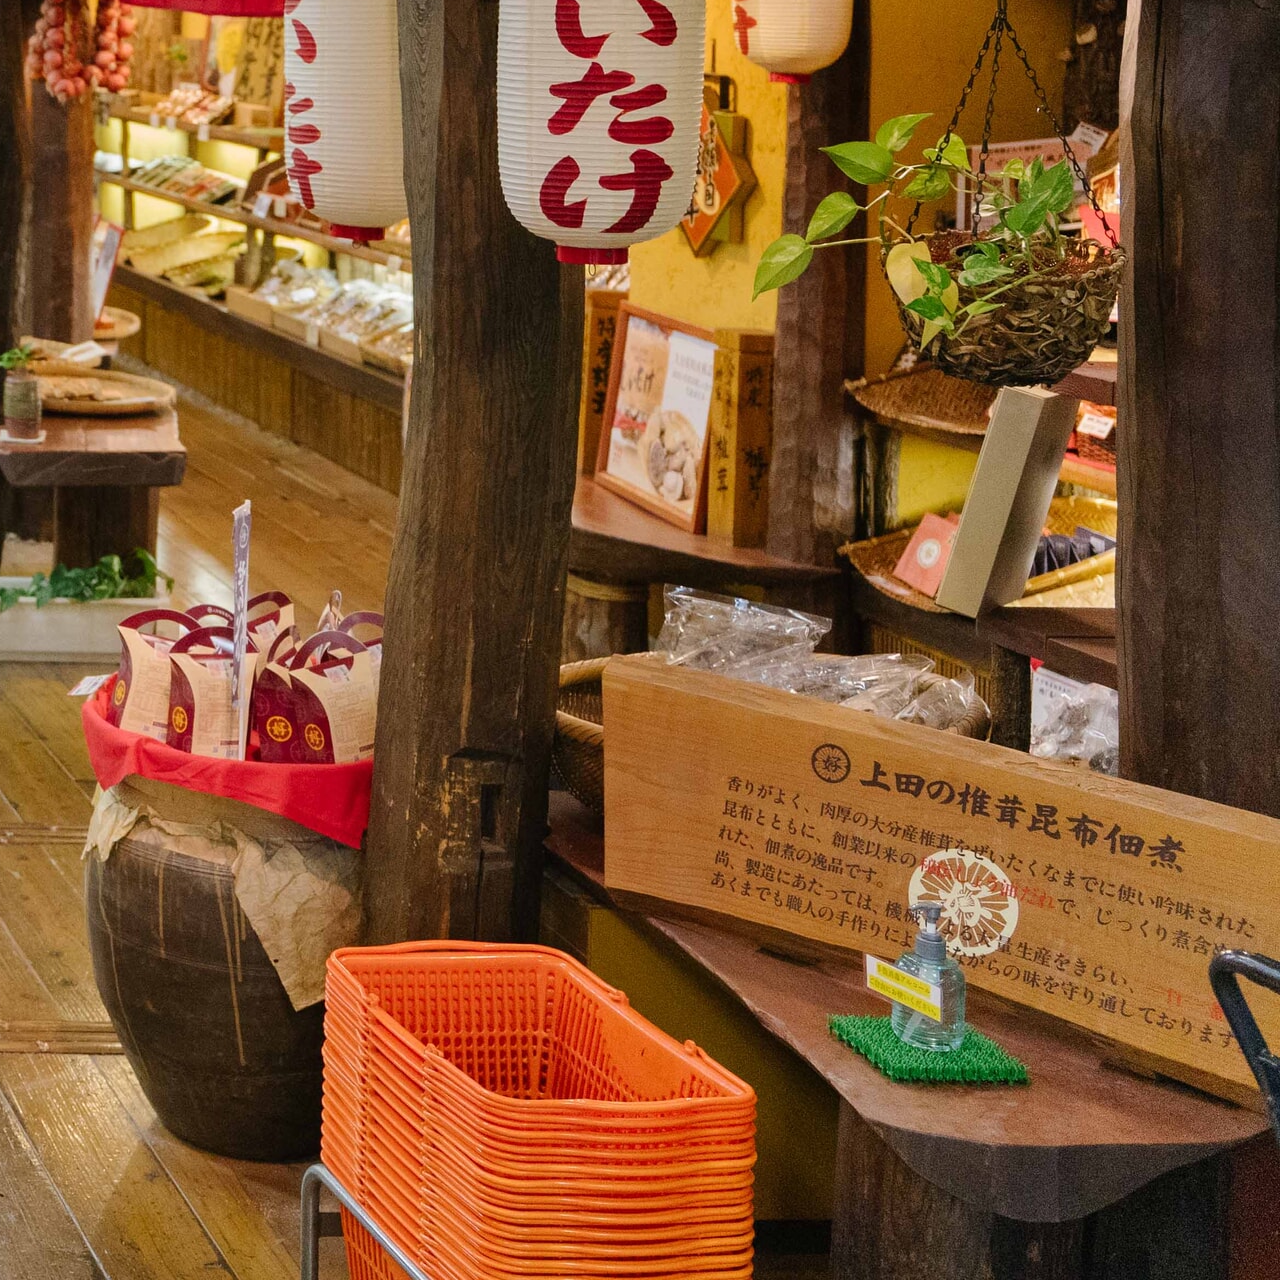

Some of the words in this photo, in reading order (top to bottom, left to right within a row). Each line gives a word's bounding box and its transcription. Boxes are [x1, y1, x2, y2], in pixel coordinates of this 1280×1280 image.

[718, 825, 884, 889] れた、佃煮の逸品です。
[859, 760, 1186, 873] 上田の椎茸昆布佃煮
[714, 850, 1136, 994] 尚、製造にあたっては、機械よる大量生産をきらい、
